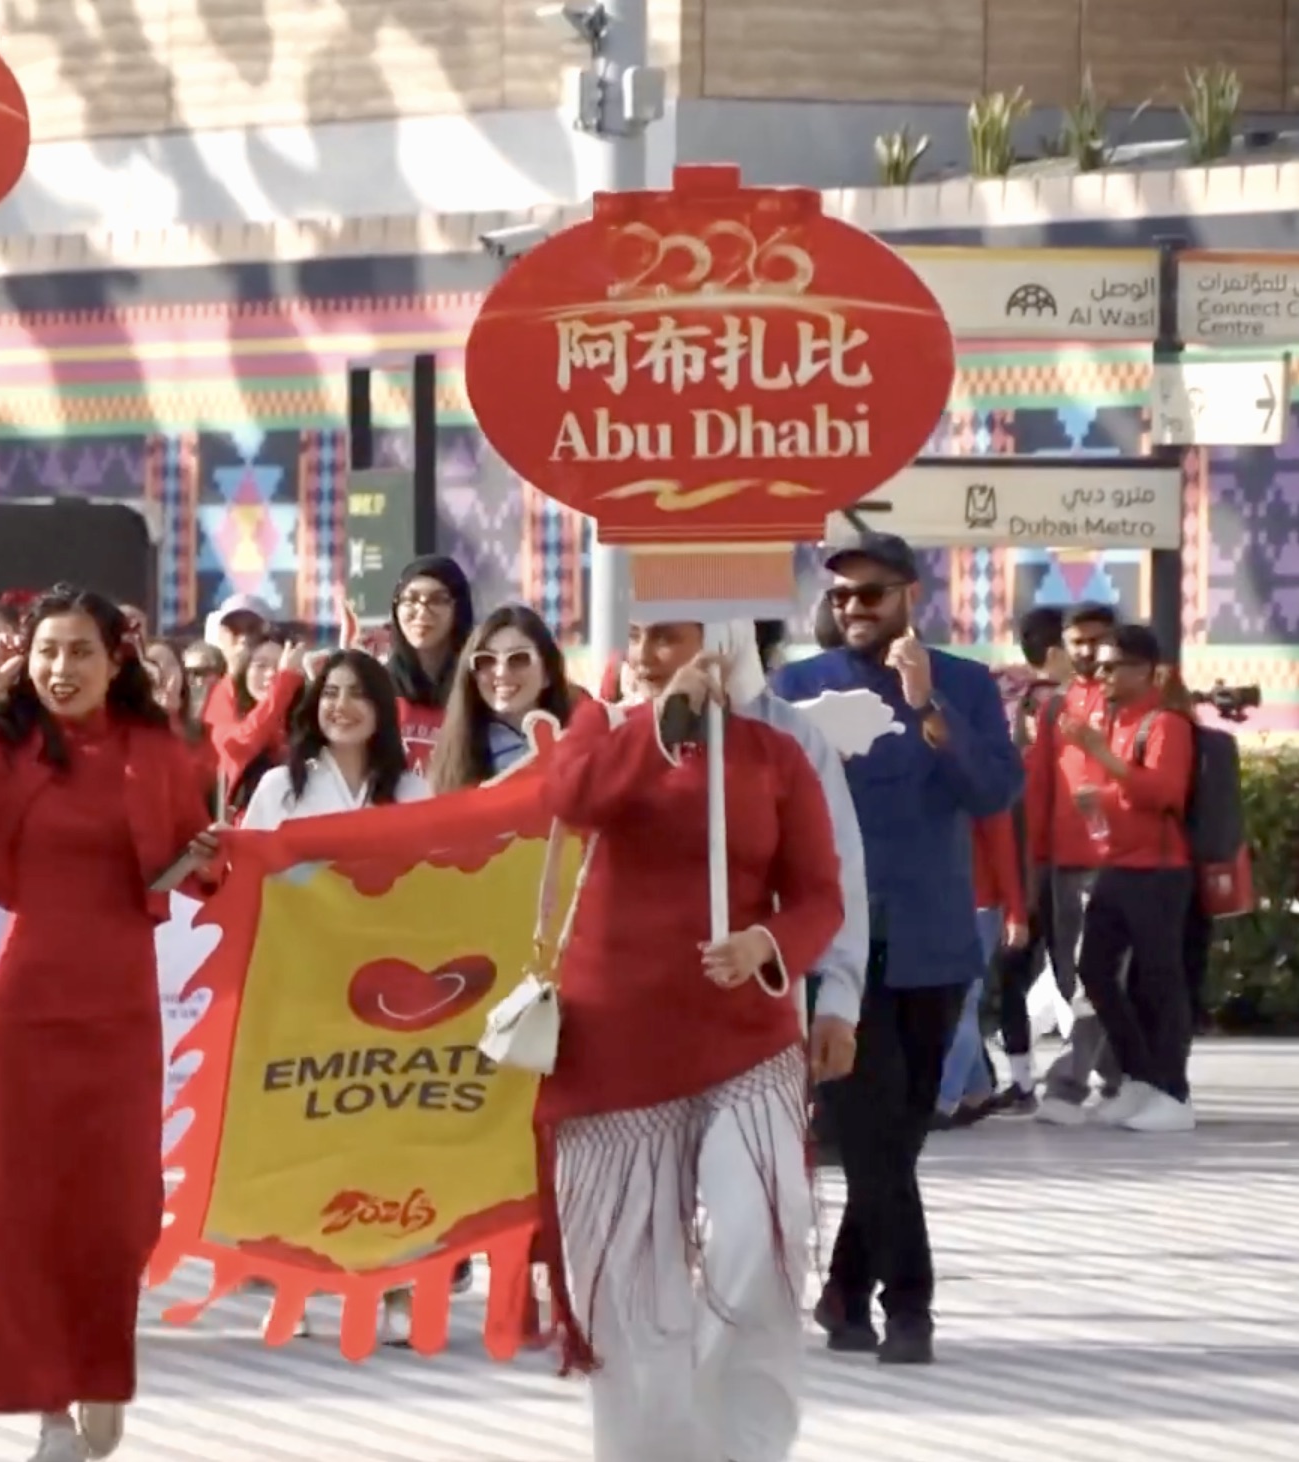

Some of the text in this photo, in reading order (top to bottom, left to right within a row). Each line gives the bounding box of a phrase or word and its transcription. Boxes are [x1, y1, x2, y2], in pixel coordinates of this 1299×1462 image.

[607, 218, 815, 296] 2026
[1090, 277, 1155, 302] الوصل
[1068, 306, 1155, 326] Al Wasl
[1197, 298, 1280, 316] Connect
[1197, 318, 1264, 336] Centre
[555, 312, 873, 394] 阿布扎比
[549, 403, 871, 461] Abu Dhabi
[1061, 487, 1155, 512] مترو دبي
[1009, 515, 1156, 536] Dubai Metro
[304, 1082, 486, 1120] LOVES
